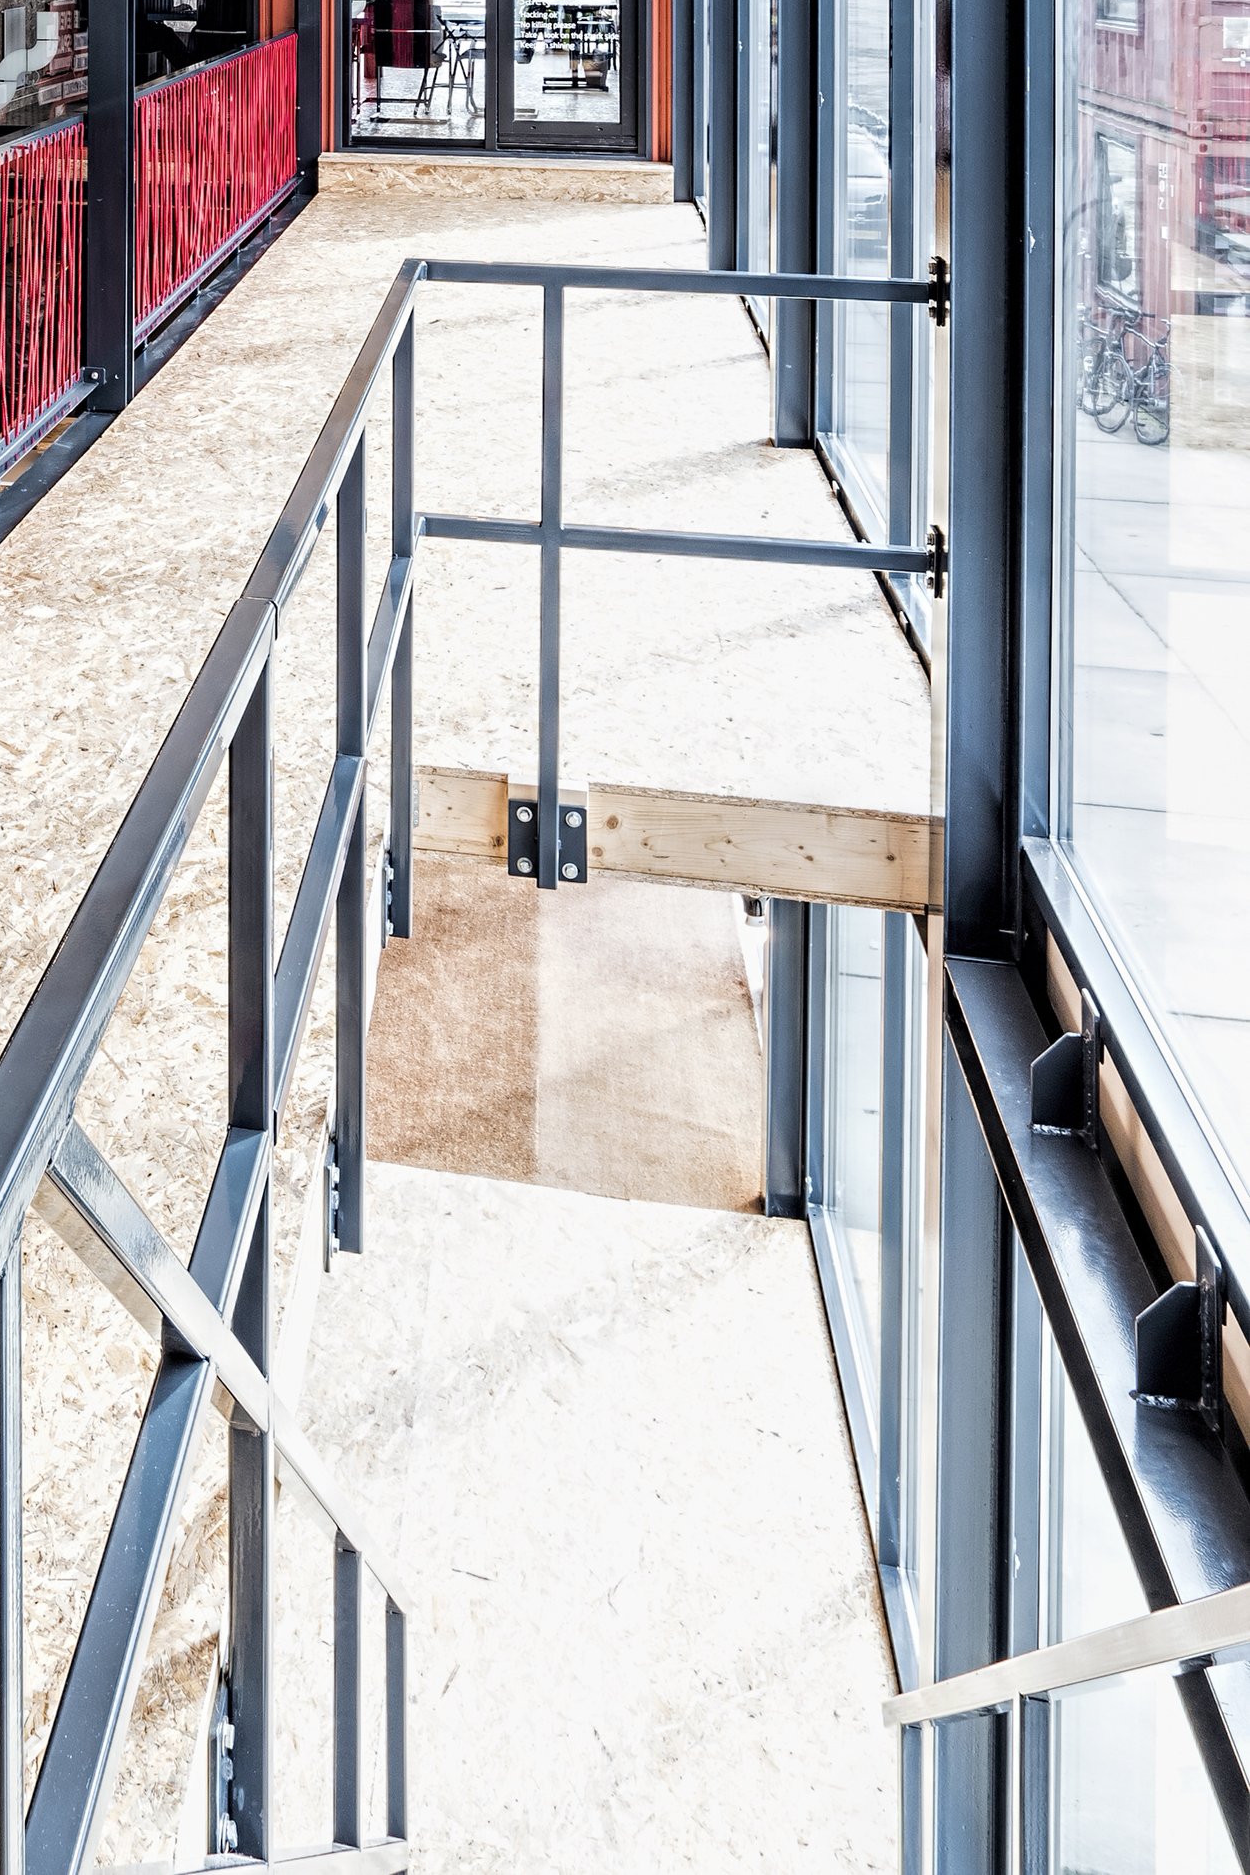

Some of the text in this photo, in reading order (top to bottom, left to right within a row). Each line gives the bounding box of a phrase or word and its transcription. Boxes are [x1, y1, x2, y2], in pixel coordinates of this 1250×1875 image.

[521, 11, 548, 20] Hacking
[532, 21, 552, 31] killing
[553, 22, 577, 31] please
[520, 31, 537, 39] Take
[544, 31, 559, 39] look
[549, 42, 575, 51] shining
